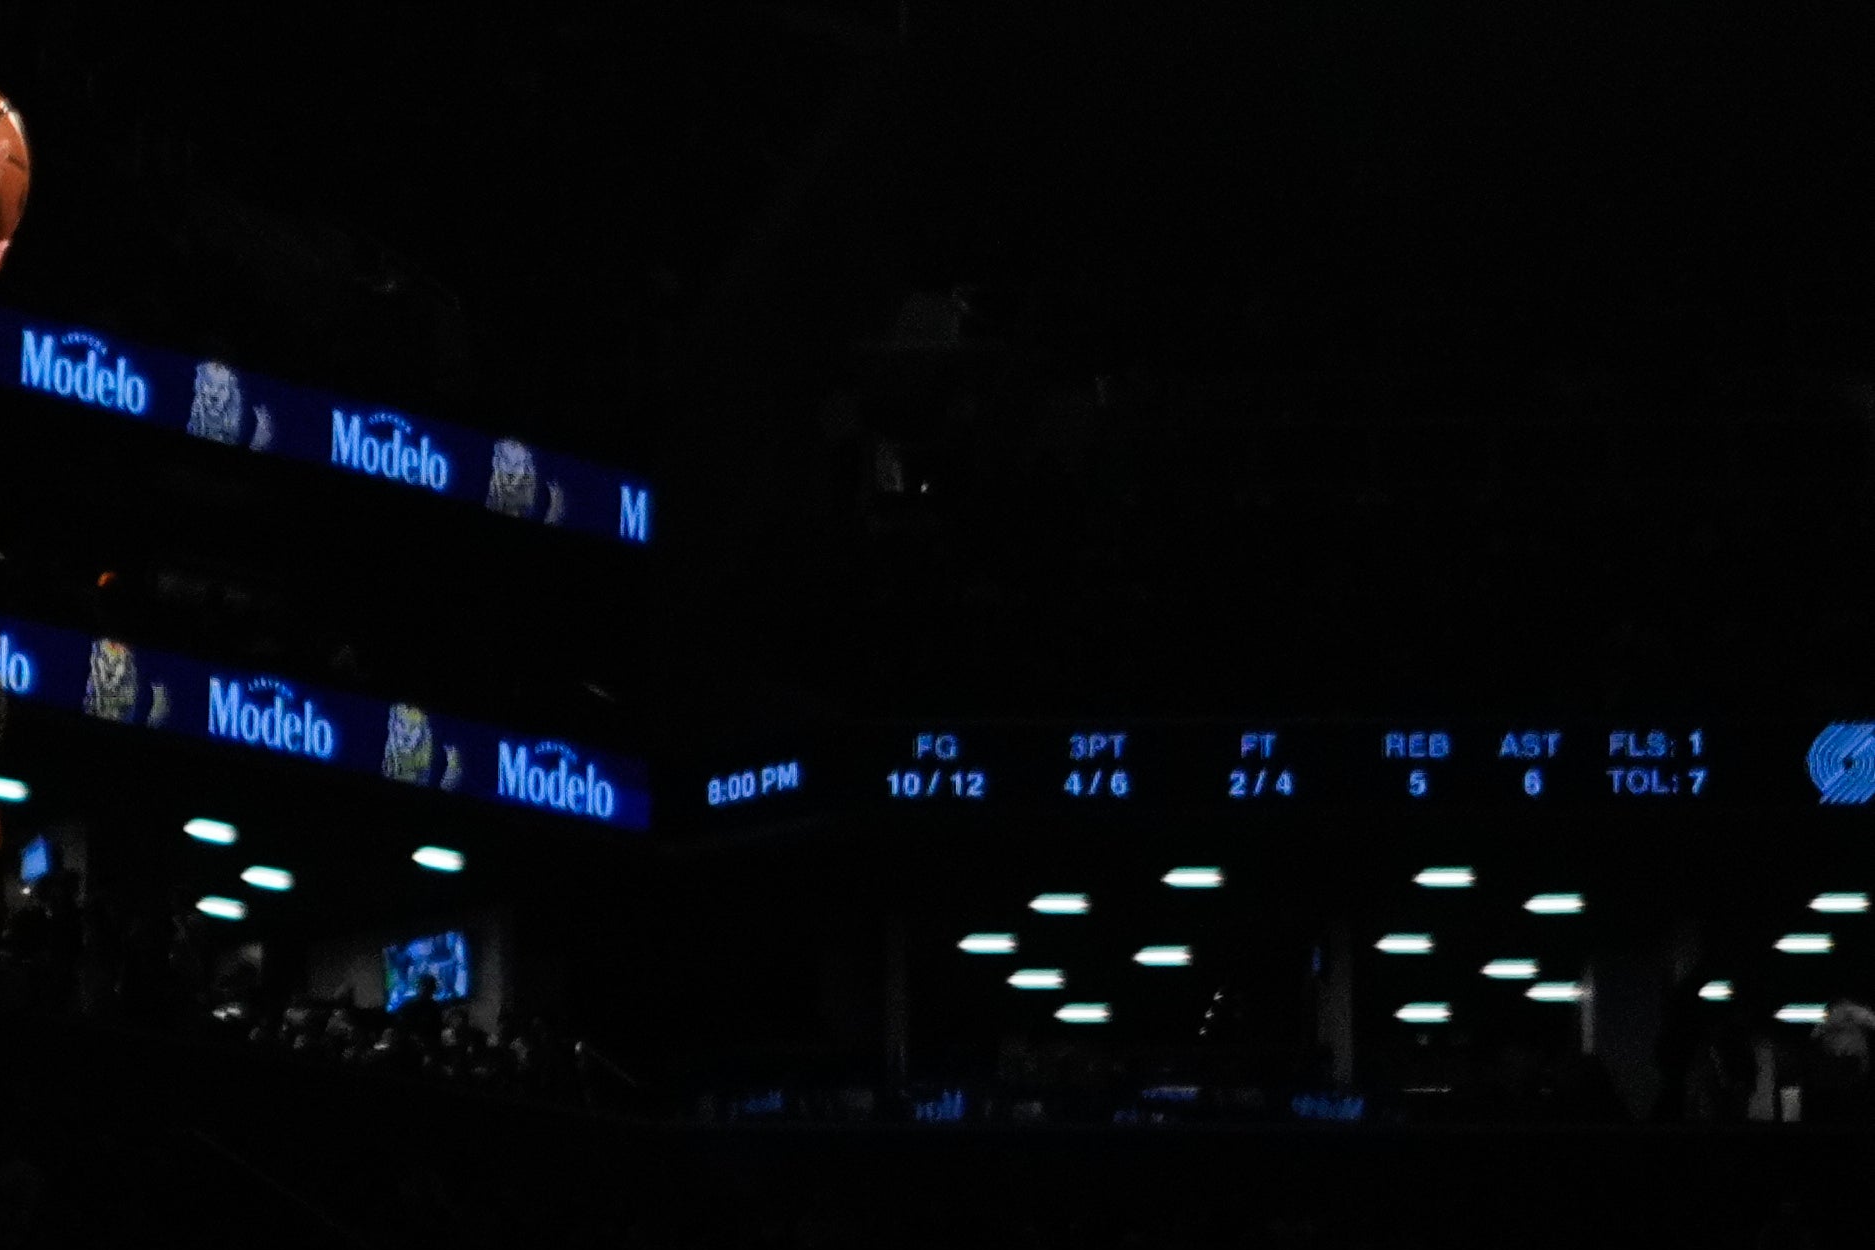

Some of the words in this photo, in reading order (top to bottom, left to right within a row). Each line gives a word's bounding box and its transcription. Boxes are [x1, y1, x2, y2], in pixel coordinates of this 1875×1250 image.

[21, 330, 146, 415] Modelo
[332, 410, 448, 490] Modelo
[208, 678, 333, 759] Modelo
[915, 734, 958, 760] FG
[1069, 733, 1126, 760] 3PT
[1240, 732, 1276, 758] FT
[1384, 731, 1450, 758] REB
[1500, 732, 1560, 758] AST
[1689, 730, 1703, 757] 1
[498, 741, 614, 818] Modelo
[707, 773, 758, 806] 8:00
[760, 761, 801, 794] PM
[1409, 770, 1427, 797] 5
[1523, 768, 1544, 796] 6
[1608, 768, 1678, 795] TOL:
[1688, 768, 1708, 796] 7
